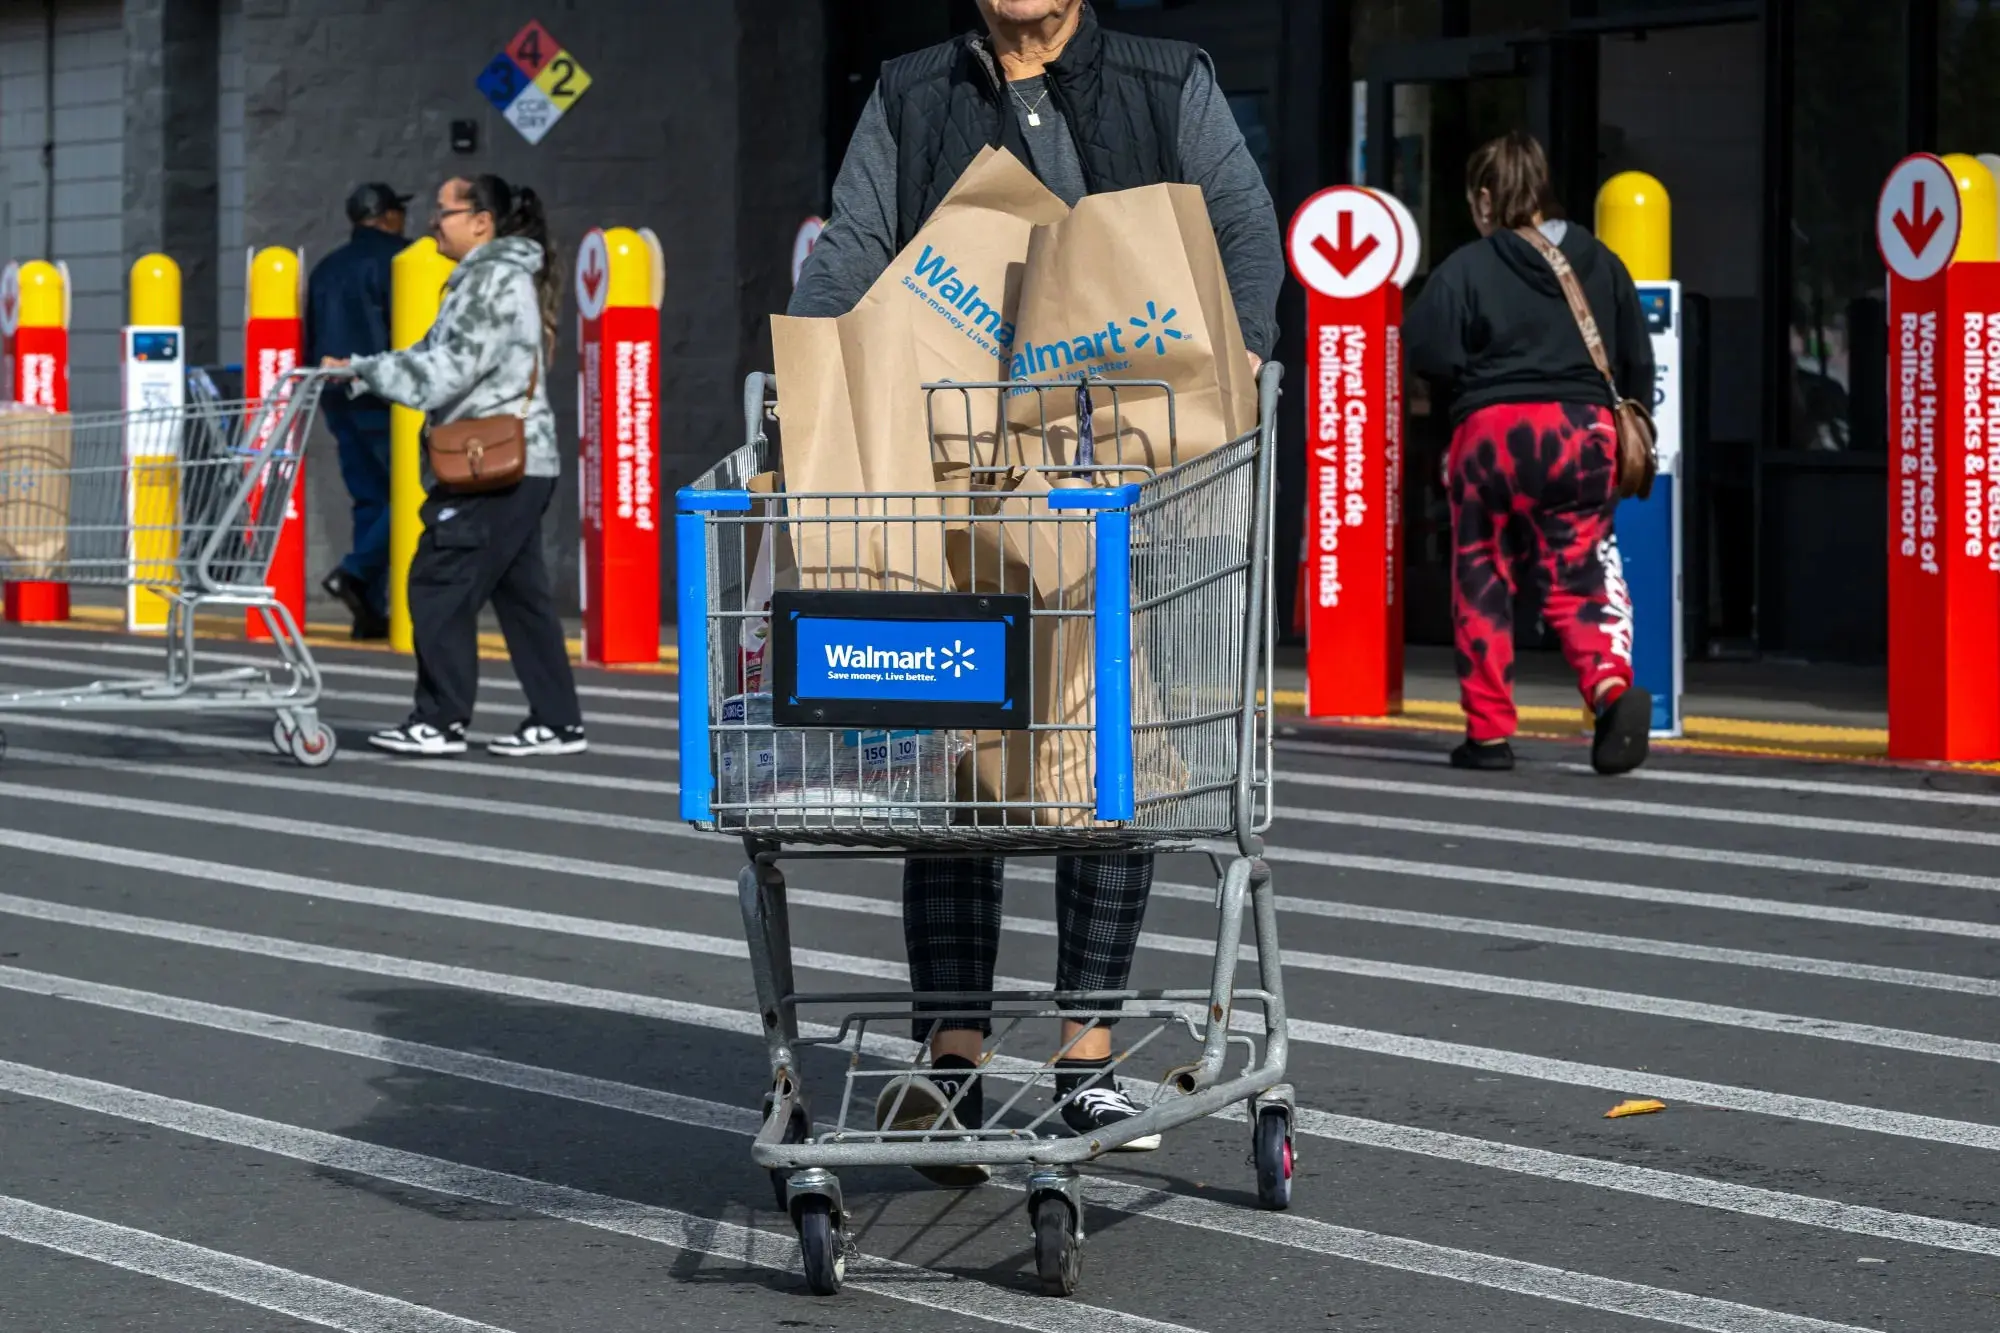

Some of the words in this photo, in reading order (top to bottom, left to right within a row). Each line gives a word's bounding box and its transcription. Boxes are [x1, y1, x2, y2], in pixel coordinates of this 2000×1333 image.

[517, 29, 543, 69] 4
[551, 59, 576, 96] 2
[490, 62, 515, 99] 3
[901, 275, 928, 300] Save
[927, 298, 965, 332] money.
[966, 328, 990, 350] Live
[914, 244, 1016, 350] Walma
[634, 341, 652, 399] Wow!
[1009, 321, 1126, 382] almart
[1088, 360, 1132, 376] better.
[1342, 325, 1367, 397] ¡Vaya!
[1920, 312, 1936, 391] Wow!
[616, 341, 633, 441] Rollbacks
[1319, 325, 1341, 441] Rollbacks
[1901, 313, 1918, 450] Rollbacks
[1964, 313, 1985, 450] Rollbacks
[617, 443, 634, 459] &
[634, 401, 654, 504] Hundreds
[1315, 447, 1338, 462] y
[1345, 399, 1367, 491] Cientos
[1901, 454, 1918, 475] &
[1920, 395, 1938, 538] Hundreds
[1965, 454, 1985, 475] &
[617, 460, 633, 518] more
[635, 505, 654, 531] of
[1319, 466, 1342, 552] mucho
[1345, 493, 1367, 526] de
[1901, 479, 1917, 557] more
[1965, 479, 1983, 557] more
[1319, 555, 1342, 608] más
[1920, 543, 1939, 575] of
[824, 644, 936, 670] Walmart
[827, 671, 849, 680] Save
[850, 674, 883, 682] money.
[885, 672, 904, 681] Live
[906, 673, 937, 682] better.
[864, 745, 887, 761] 150
